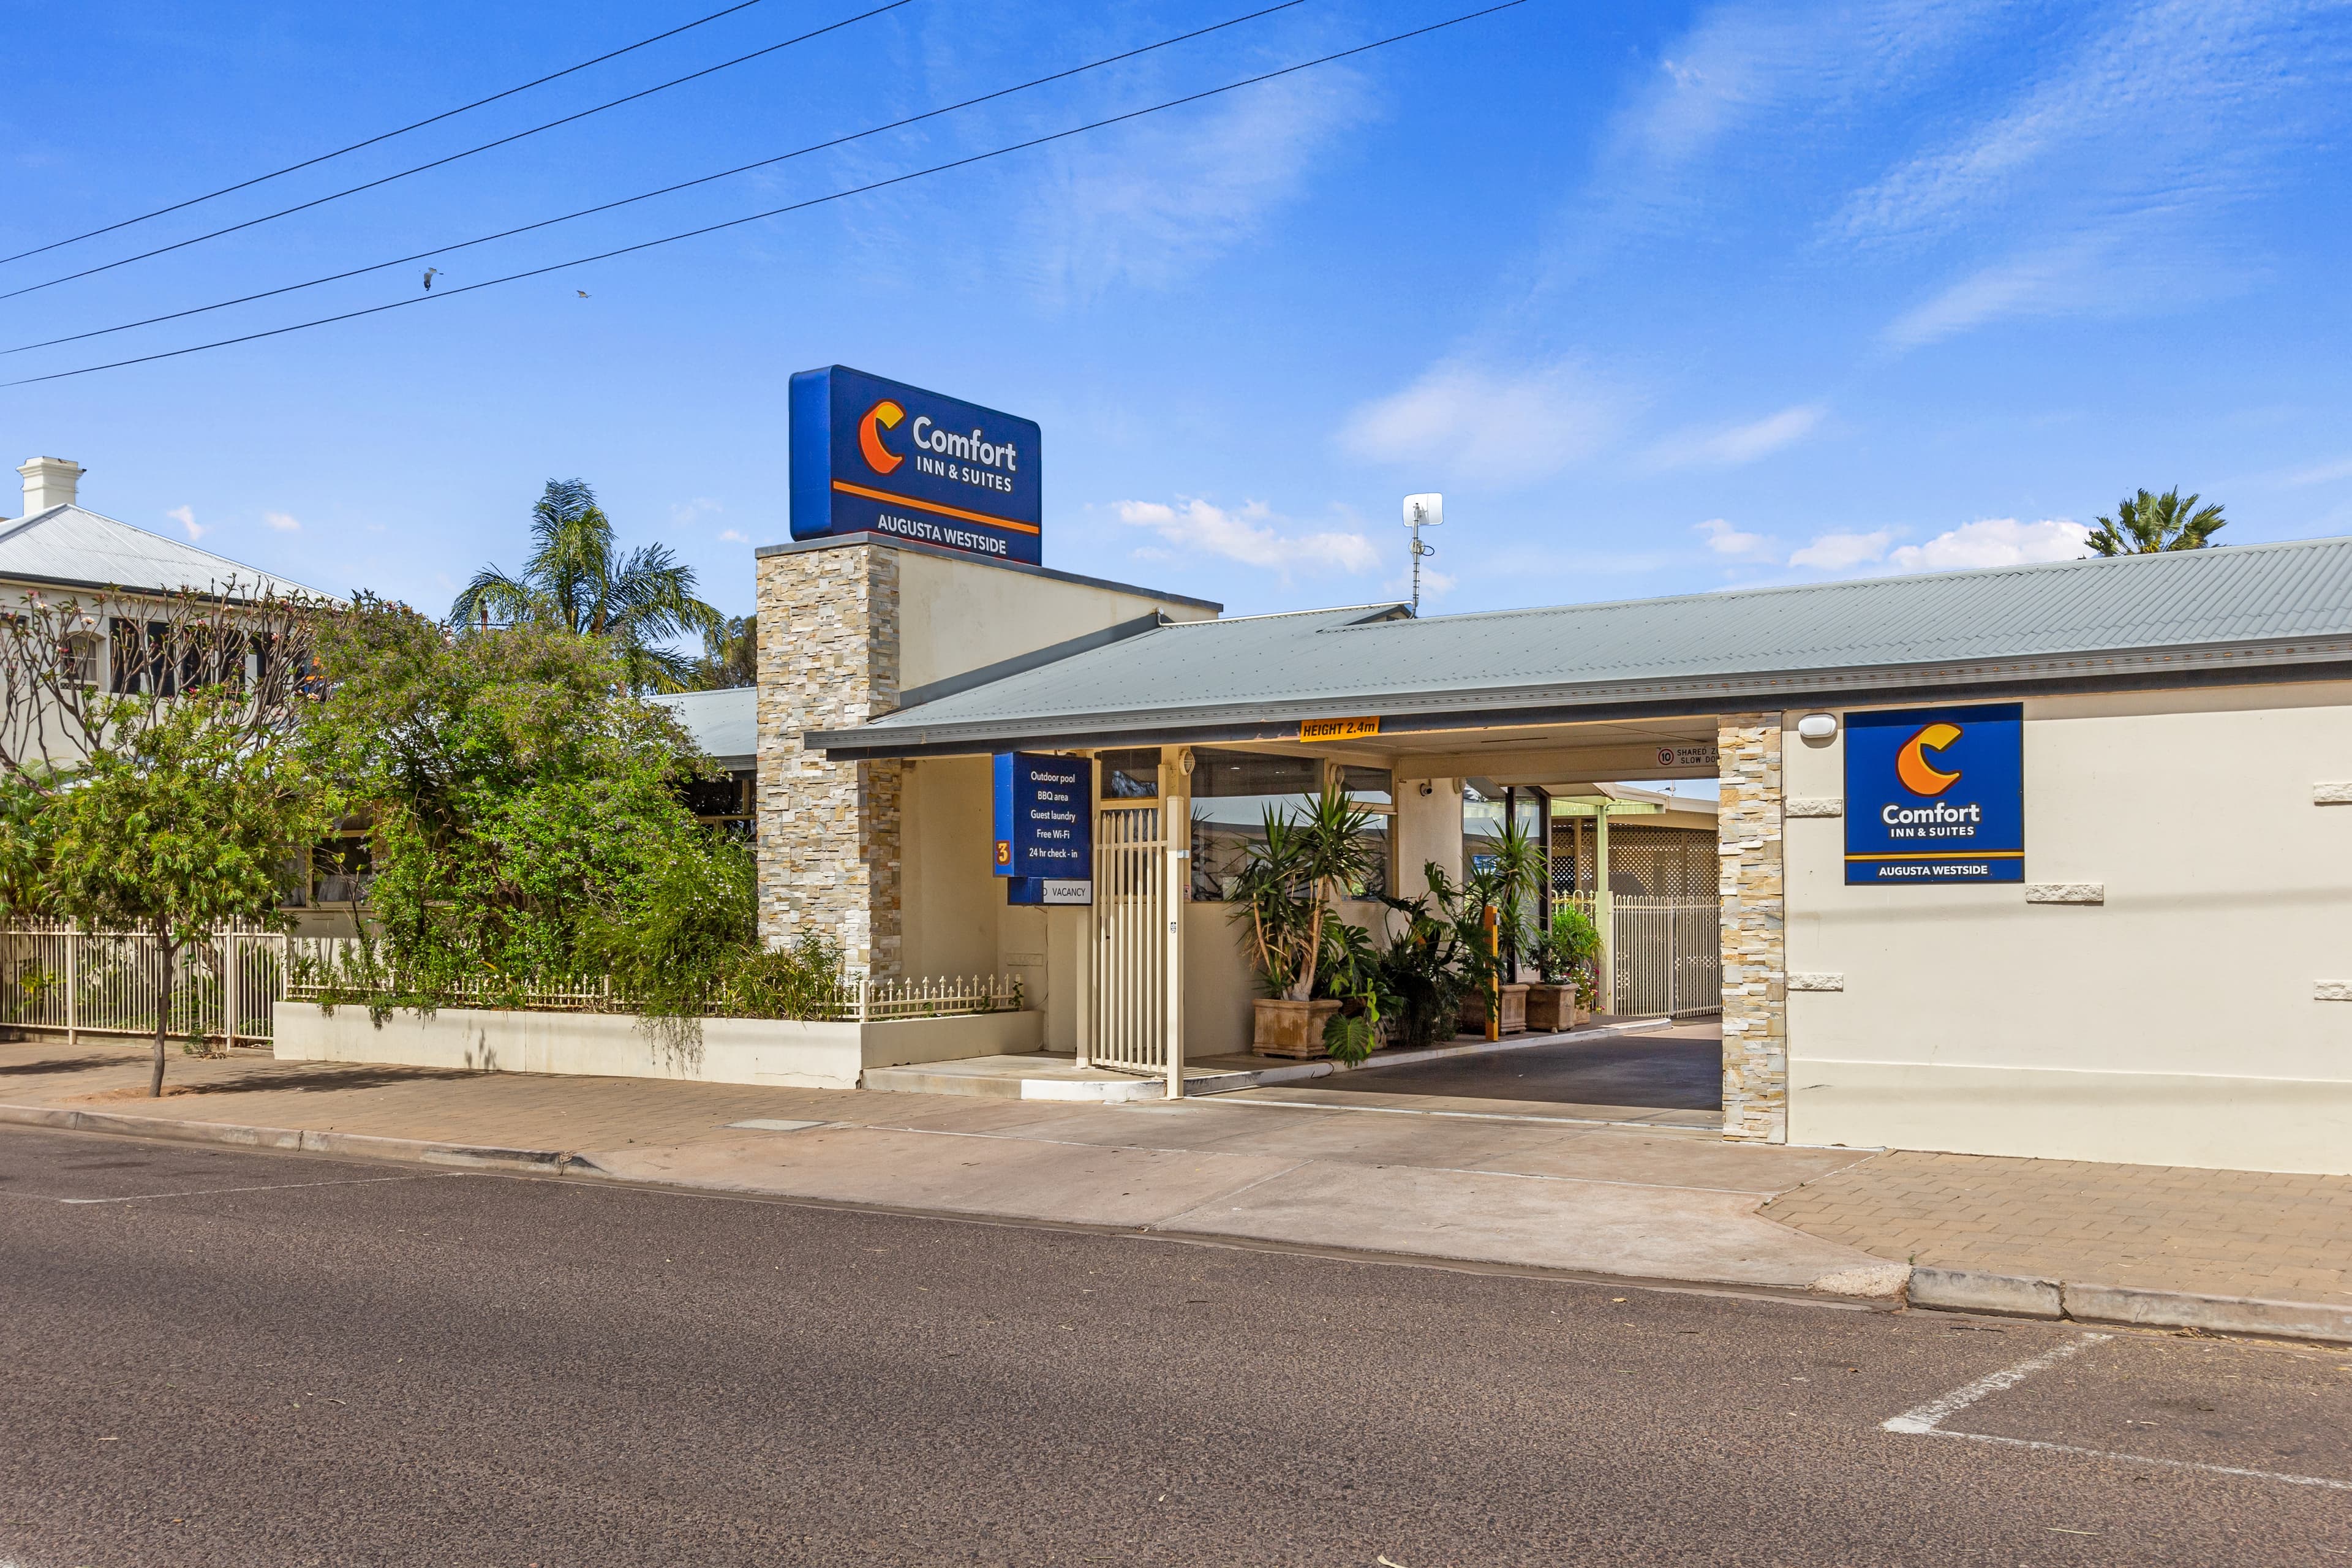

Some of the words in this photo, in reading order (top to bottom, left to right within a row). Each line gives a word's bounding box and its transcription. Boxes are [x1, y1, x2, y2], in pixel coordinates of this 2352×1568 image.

[913, 417, 1016, 471] Comfort
[917, 456, 944, 476] INN
[949, 464, 958, 480] &
[962, 467, 1011, 492] SUITES
[878, 514, 941, 541] AUGUSTA
[944, 529, 1006, 554] WESTSIDE
[1303, 723, 1343, 737] HEIGHT
[1346, 722, 1375, 734] 2.4m
[1662, 753, 1671, 761] 10
[1031, 771, 1059, 782] Outdoor
[1060, 774, 1075, 785] pool
[1038, 791, 1053, 801] BBQ
[1031, 810, 1050, 820] Guest
[1051, 810, 1076, 823] laundry
[1883, 802, 1980, 824] Comfort
[1037, 829, 1052, 839] Free
[1053, 830, 1070, 839] Wi-Fi
[1891, 828, 1914, 837] INN
[1929, 827, 1974, 836] SUITES
[998, 843, 1008, 862] 3
[1029, 848, 1038, 857] 24
[1039, 848, 1047, 857] hr
[1048, 848, 1066, 858] check
[1879, 866, 1931, 876] AUGUSTA
[1932, 865, 1988, 875] WESTSIDE
[1052, 888, 1085, 896] VACANCY
